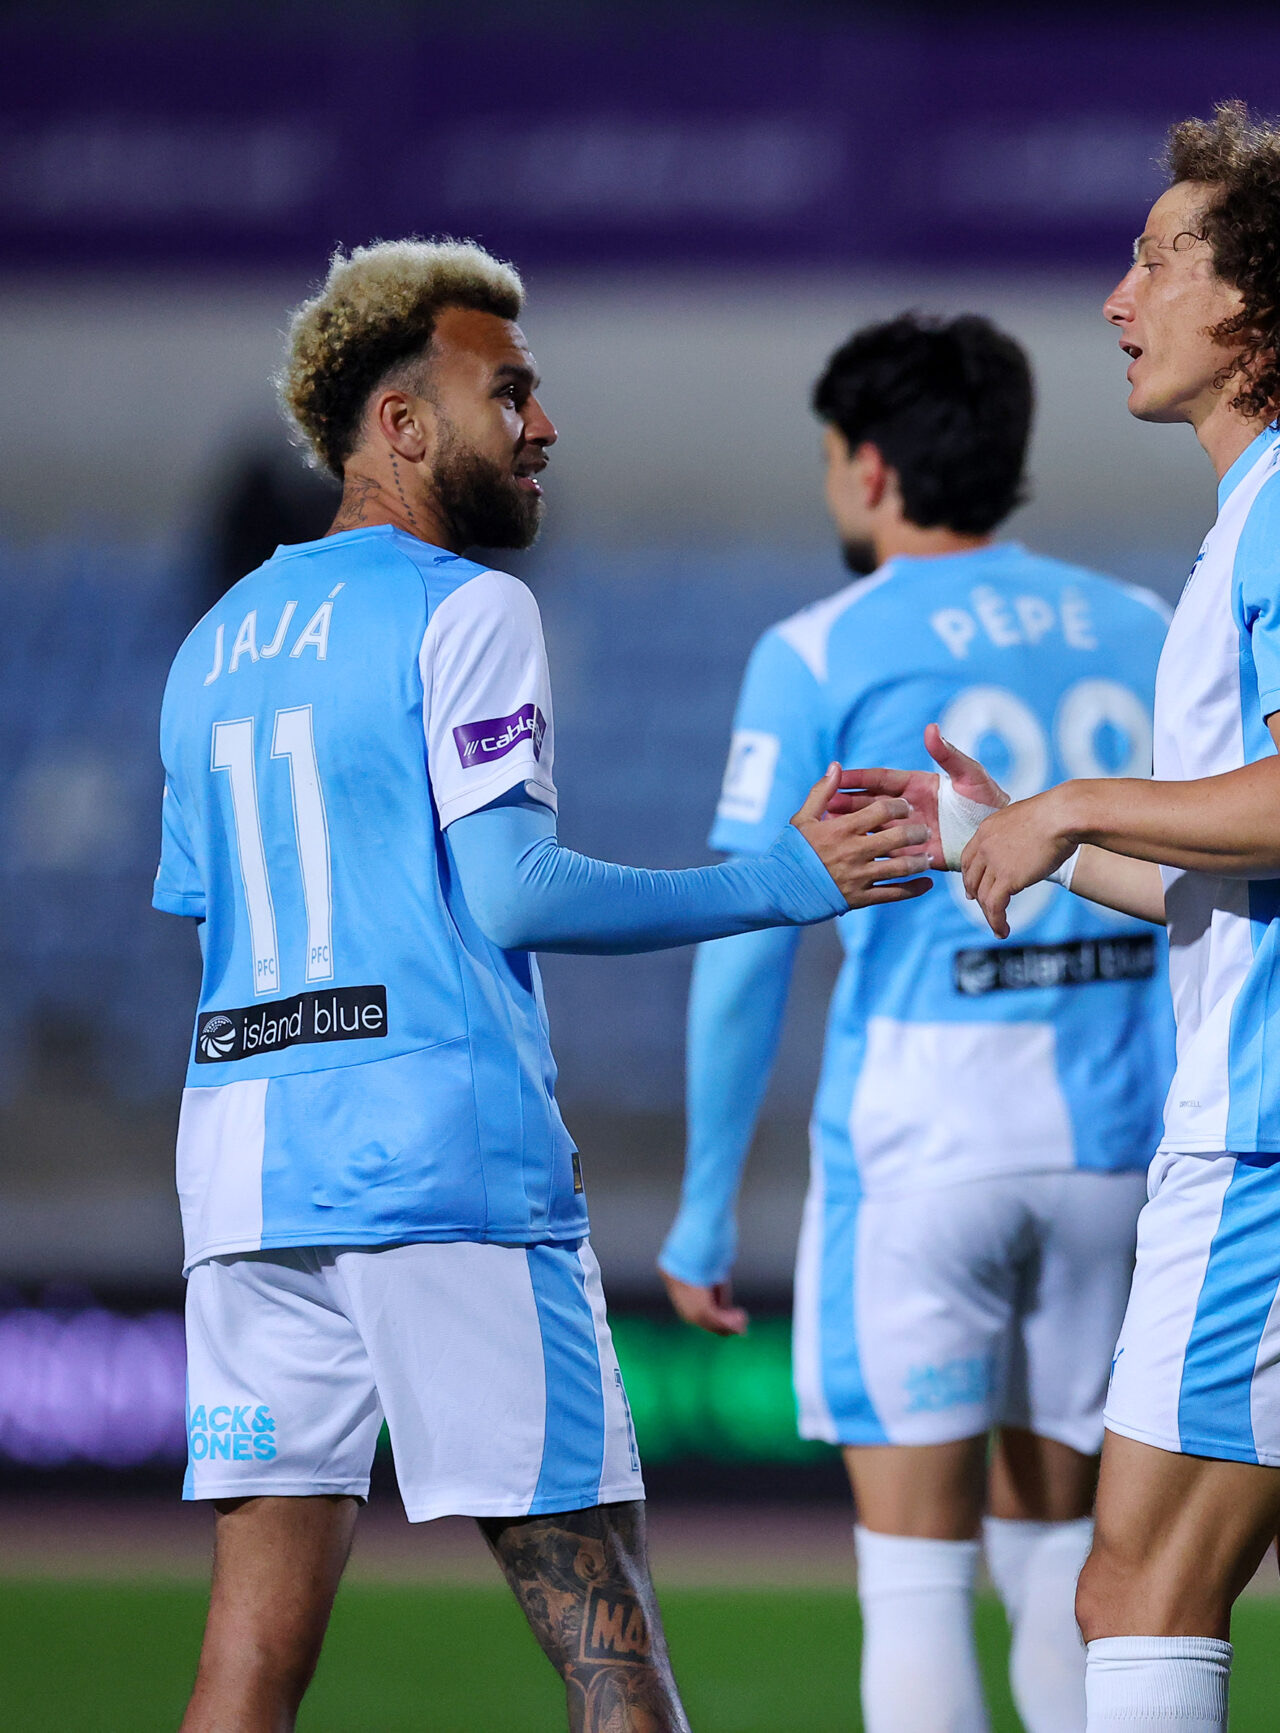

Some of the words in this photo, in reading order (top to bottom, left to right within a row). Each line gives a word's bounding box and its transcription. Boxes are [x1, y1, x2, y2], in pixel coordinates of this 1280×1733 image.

[203, 582, 346, 687] JAJÁ
[211, 703, 332, 997] 11
[258, 958, 275, 977] PFC
[311, 945, 328, 964] PFC
[243, 1001, 303, 1051] island
[314, 997, 384, 1035] blue
[191, 1404, 277, 1433] ACK&
[191, 1432, 278, 1461] ONES
